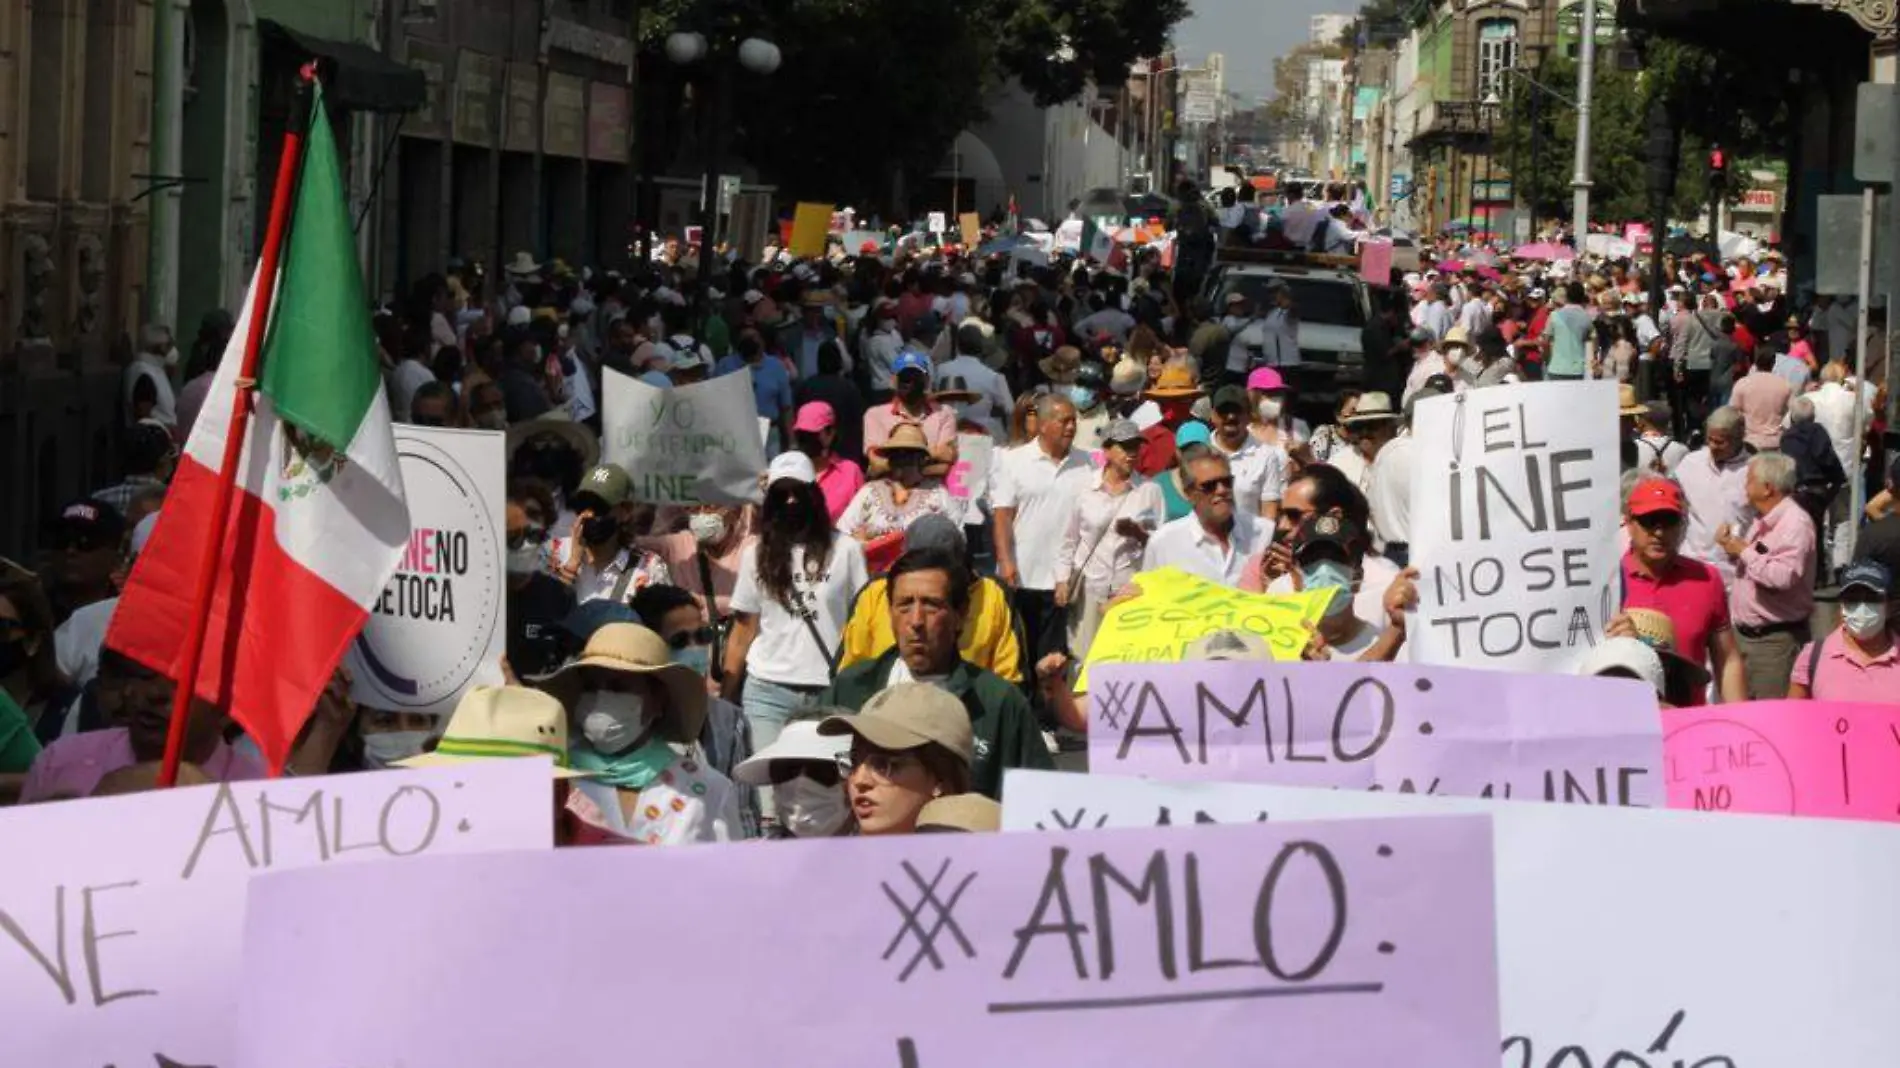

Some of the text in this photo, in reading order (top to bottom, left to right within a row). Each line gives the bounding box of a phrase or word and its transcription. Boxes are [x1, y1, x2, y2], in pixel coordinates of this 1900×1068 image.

[644, 473, 700, 502] INE
[1434, 547, 1592, 606] NO SE
[1694, 783, 1732, 812] NO
